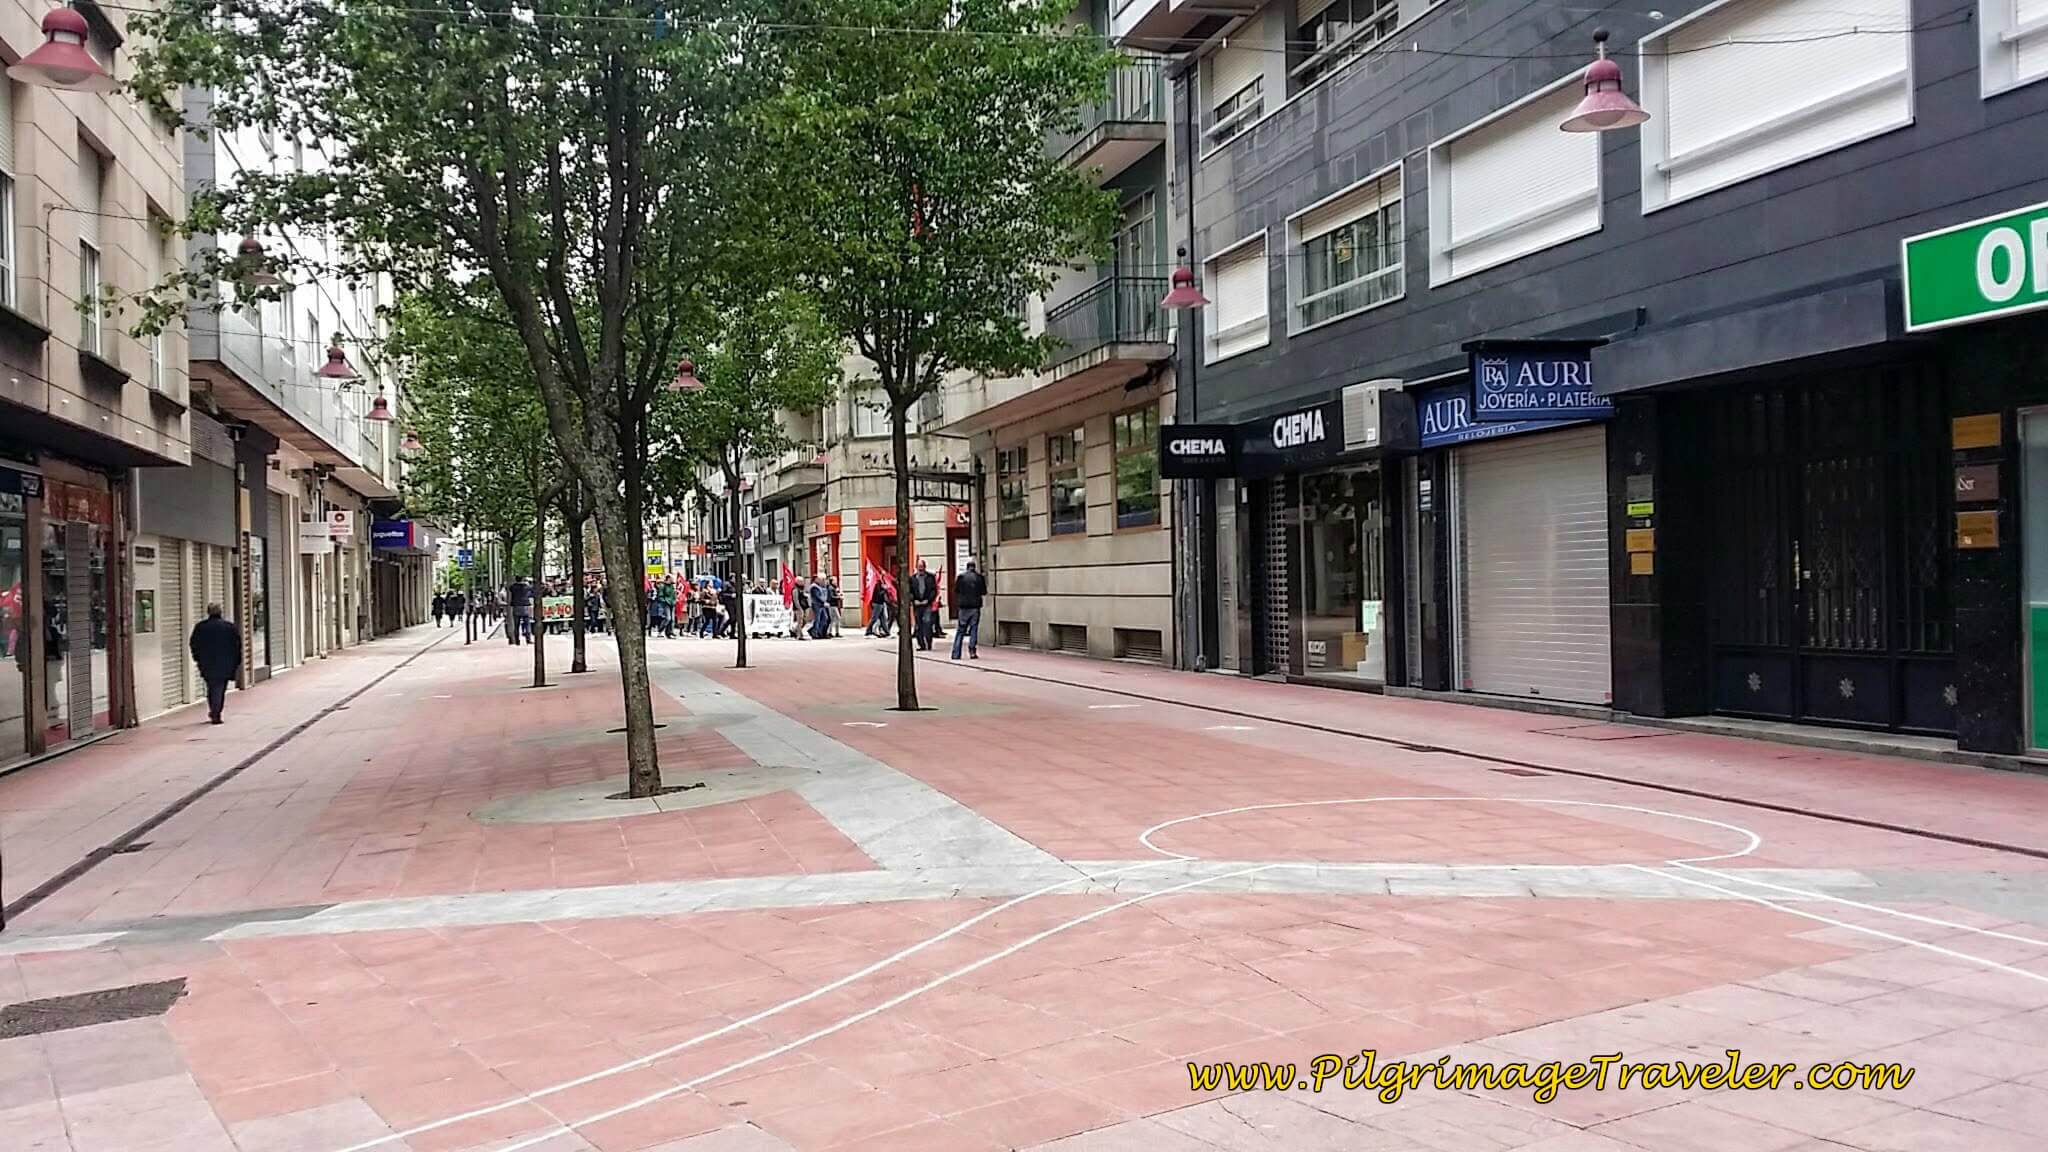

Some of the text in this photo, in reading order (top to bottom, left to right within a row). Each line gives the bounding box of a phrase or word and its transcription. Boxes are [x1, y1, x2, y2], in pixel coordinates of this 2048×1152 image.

[1516, 361, 1593, 387] AURI
[1273, 409, 1326, 449] CHEMA
[1169, 439, 1227, 455] CHEMA
